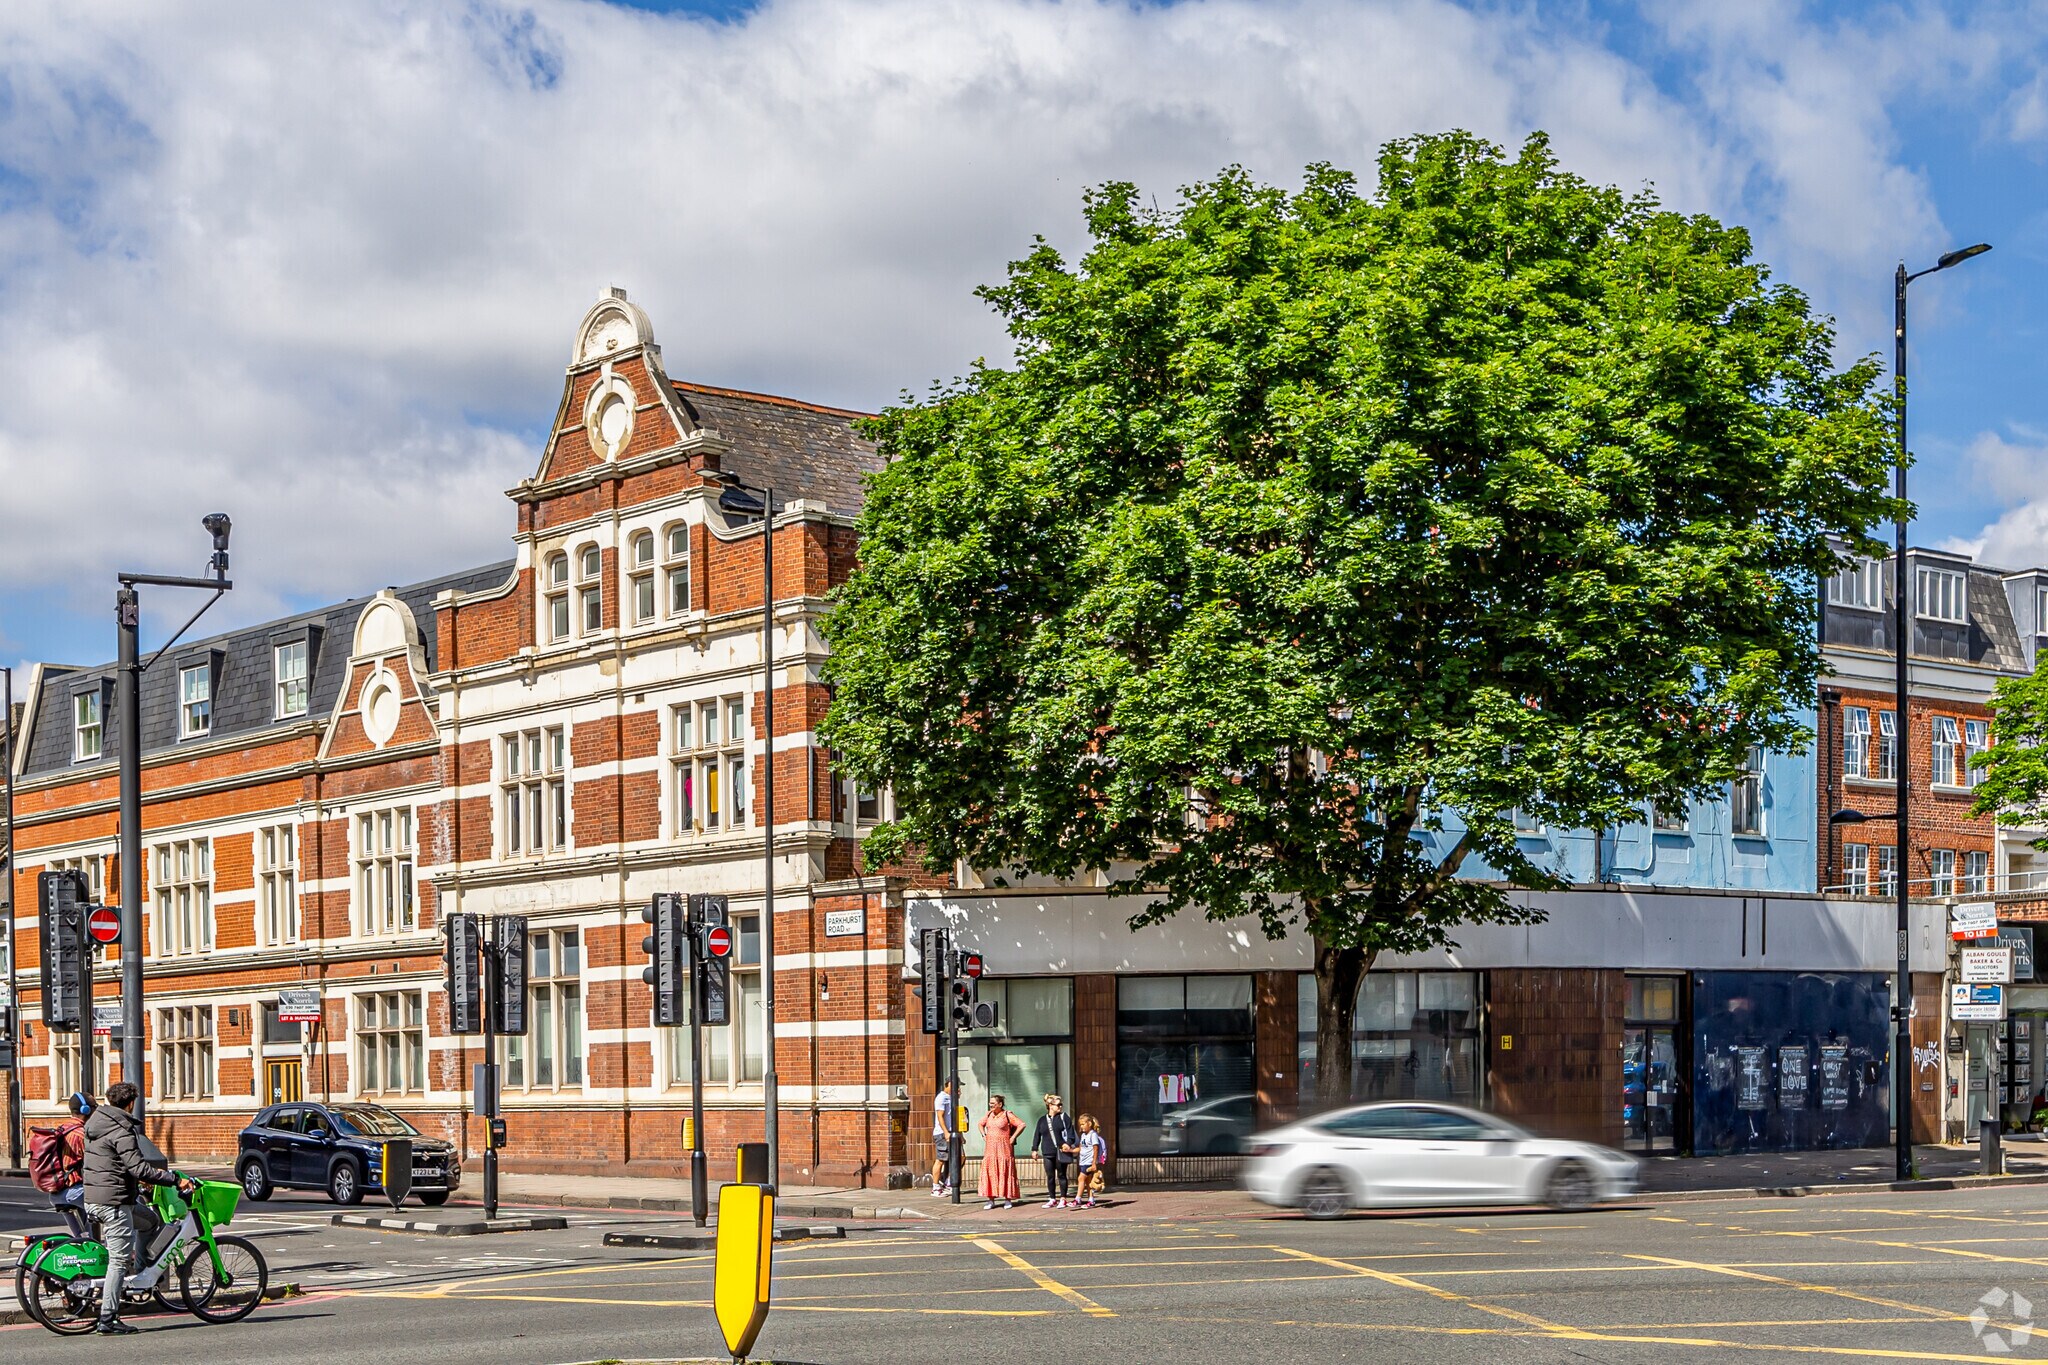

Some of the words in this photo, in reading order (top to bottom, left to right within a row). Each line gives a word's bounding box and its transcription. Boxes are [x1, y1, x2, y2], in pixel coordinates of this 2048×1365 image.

[1959, 904, 1985, 914] Drivers
[828, 915, 861, 925] PARKHURST
[828, 925, 845, 933] ROAD
[1995, 934, 2026, 948] Drivers
[2014, 951, 2030, 966] rris
[1782, 1057, 1802, 1074] ONE
[1781, 1074, 1808, 1090] LOVE
[274, 1088, 282, 1098] 99
[158, 1238, 184, 1269] Lime
